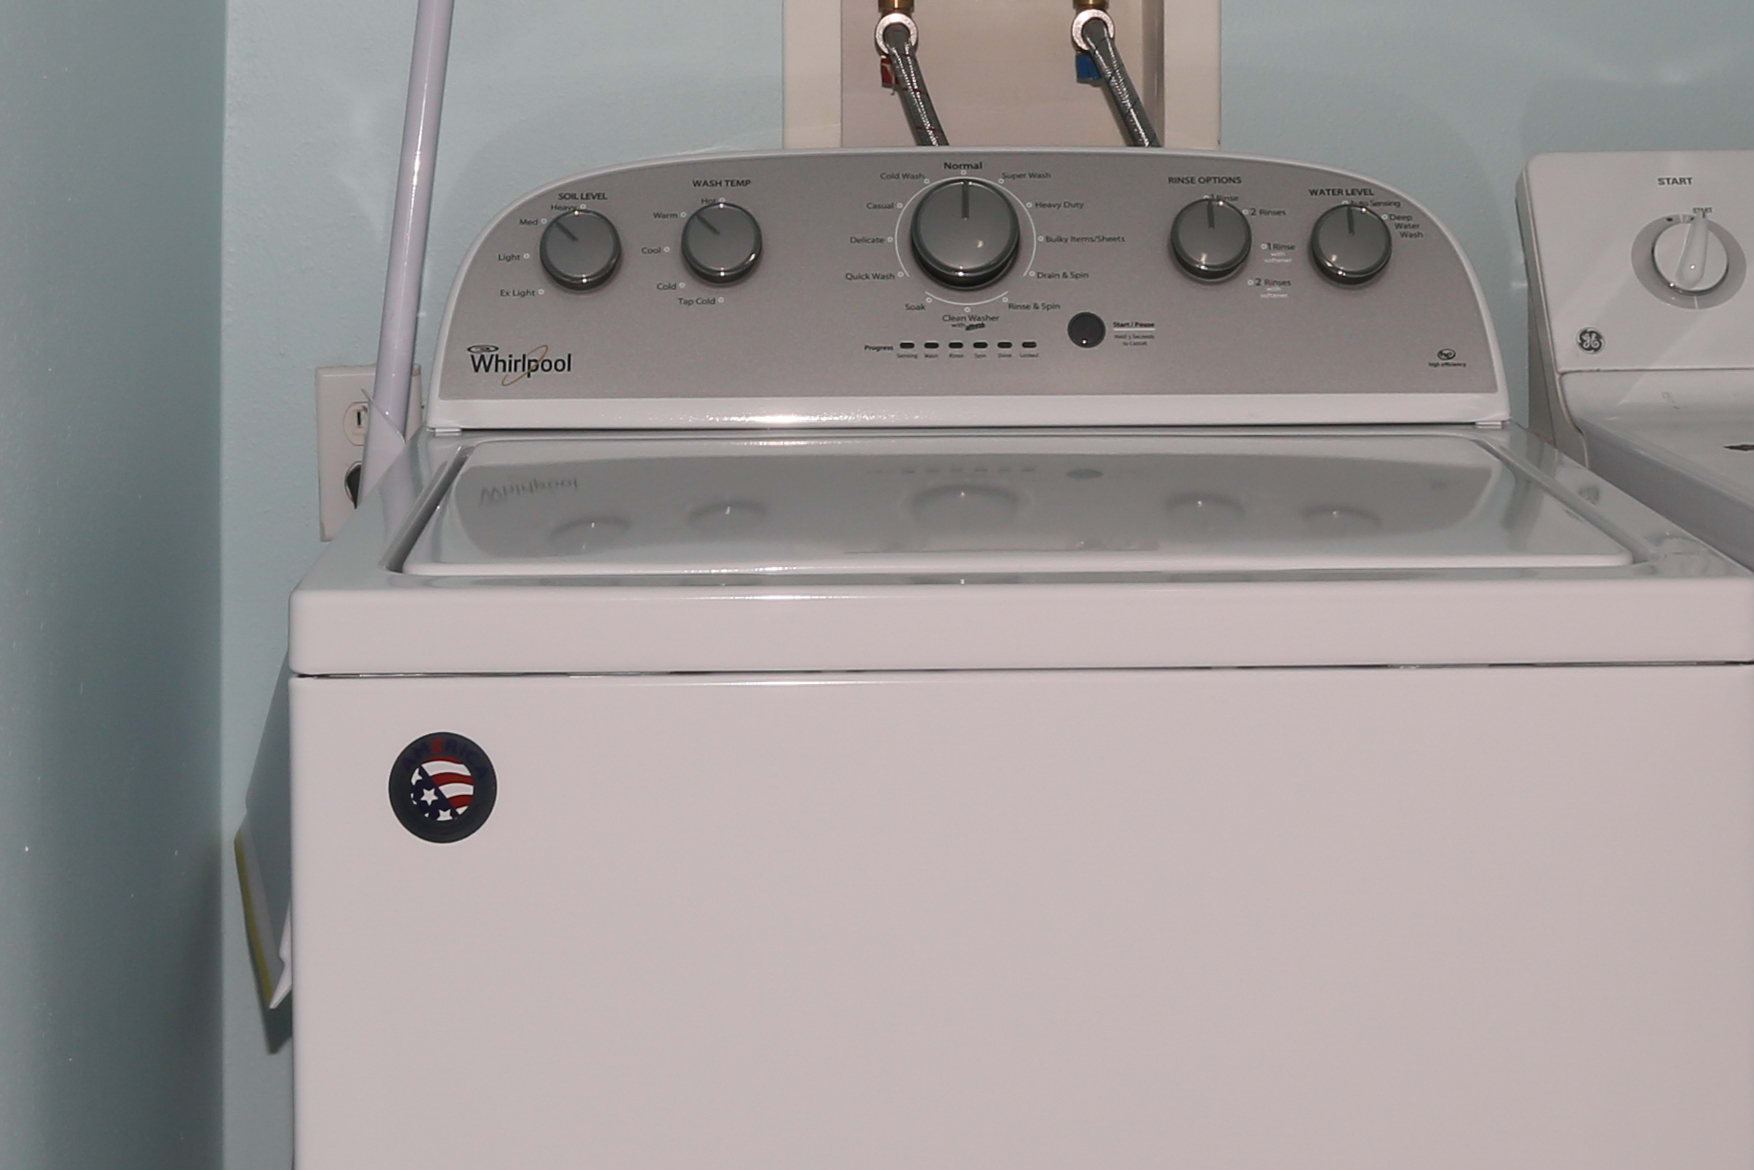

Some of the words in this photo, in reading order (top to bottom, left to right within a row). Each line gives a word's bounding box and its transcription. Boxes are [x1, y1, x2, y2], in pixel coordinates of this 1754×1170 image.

[943, 162, 983, 170] Normal
[880, 172, 900, 180] Cold
[902, 172, 925, 180] Wash
[1001, 172, 1026, 180] Super
[1168, 176, 1196, 184] RINSE
[1198, 176, 1242, 184] OPTIONS
[692, 179, 722, 187] WASH
[725, 179, 751, 187] TEMP
[1657, 177, 1693, 185] START
[558, 192, 578, 200] SOIL
[581, 192, 608, 200] LEVEL
[1308, 188, 1344, 196] WATER
[1345, 188, 1375, 196] LEVEL
[1035, 201, 1061, 210] Heavy
[1063, 201, 1084, 209] Duty
[1370, 200, 1401, 208] Sensing
[1251, 208, 1257, 216] 2
[850, 236, 884, 244] Delicate
[1070, 235, 1126, 243] Items/Sheets
[498, 254, 520, 262] Light
[1070, 272, 1089, 280] Spin
[656, 282, 677, 290] Cold
[1256, 278, 1261, 286] 2
[500, 289, 511, 297] Ex
[512, 289, 535, 298] Light
[678, 298, 694, 306] Tap
[695, 297, 716, 305] Cold
[905, 303, 926, 311] Soak
[1041, 303, 1061, 311] Spin
[942, 314, 967, 322] Clean
[968, 314, 1000, 322] Washer
[470, 353, 572, 379] Whirlpool
